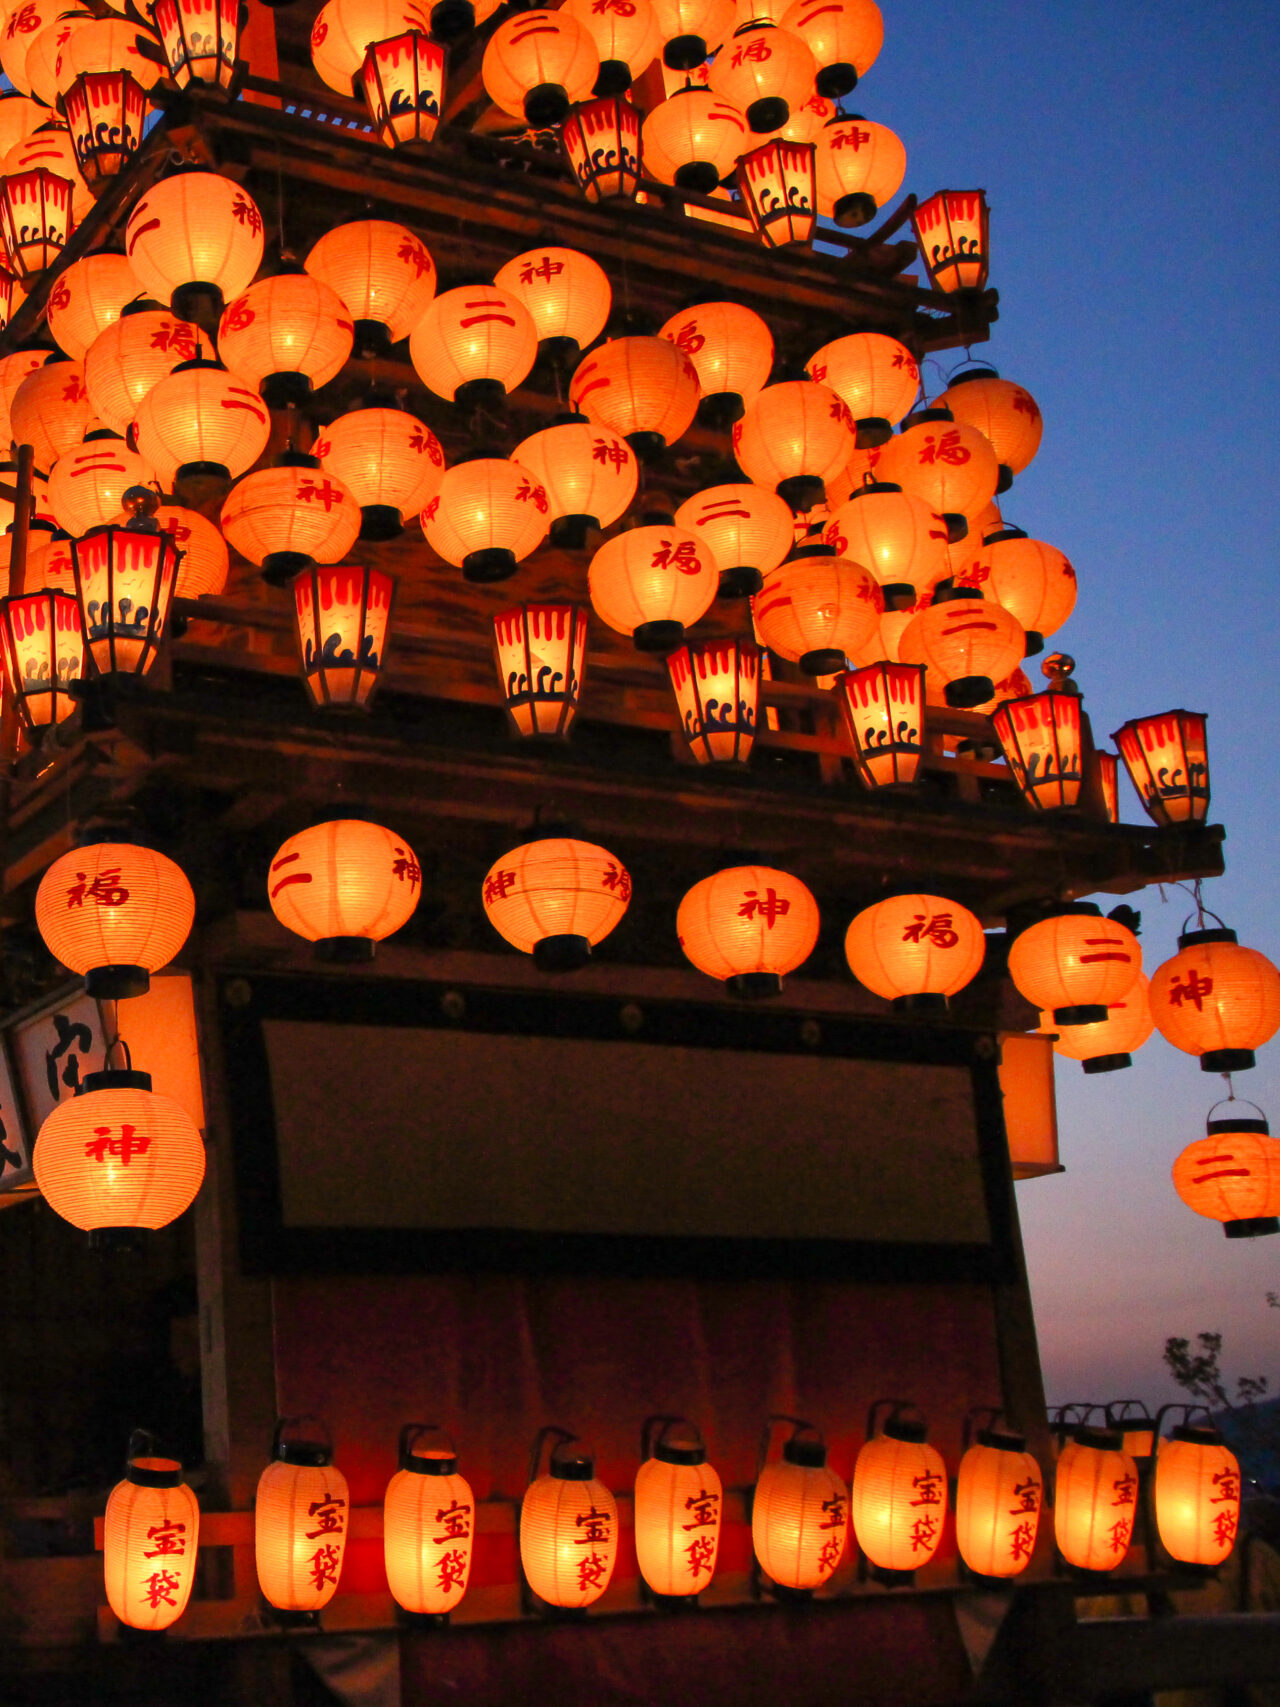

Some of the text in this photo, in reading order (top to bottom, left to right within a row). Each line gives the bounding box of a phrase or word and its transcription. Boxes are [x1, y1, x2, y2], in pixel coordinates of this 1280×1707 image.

[6, 3, 42, 40] 福
[510, 15, 560, 45] 二
[732, 38, 772, 69] 福
[707, 102, 745, 132] 二
[19, 139, 64, 165] 二
[830, 126, 870, 152] 神
[397, 234, 431, 279] 神
[520, 257, 564, 285] 神
[460, 301, 516, 329] 二
[574, 362, 611, 405] 二
[221, 387, 266, 424] 二
[70, 452, 126, 477] 二
[593, 438, 629, 486] 神
[919, 430, 970, 465] 福
[297, 478, 344, 512] 神
[696, 500, 751, 527] 二
[651, 540, 702, 575] 福
[941, 608, 997, 636] 二
[66, 868, 129, 909] 福
[272, 852, 312, 898] 二
[392, 847, 420, 895] 神
[485, 870, 516, 904] 神
[738, 888, 790, 930] 神
[902, 913, 959, 949] 福
[1080, 938, 1132, 964] 二
[1169, 970, 1213, 1012] 神
[84, 1124, 151, 1167] 神
[1192, 1154, 1250, 1184] 二
[909, 1468, 943, 1553] 宝袋
[1008, 1476, 1041, 1561] 宝袋
[1106, 1472, 1138, 1554] 宝袋
[1209, 1466, 1240, 1548] 宝袋
[305, 1493, 345, 1591] 宝袋
[433, 1500, 471, 1593] 宝袋
[574, 1506, 611, 1592] 宝袋
[681, 1489, 719, 1577] 宝袋
[818, 1493, 846, 1574] 宝袋
[139, 1520, 186, 1609] 宝袋
